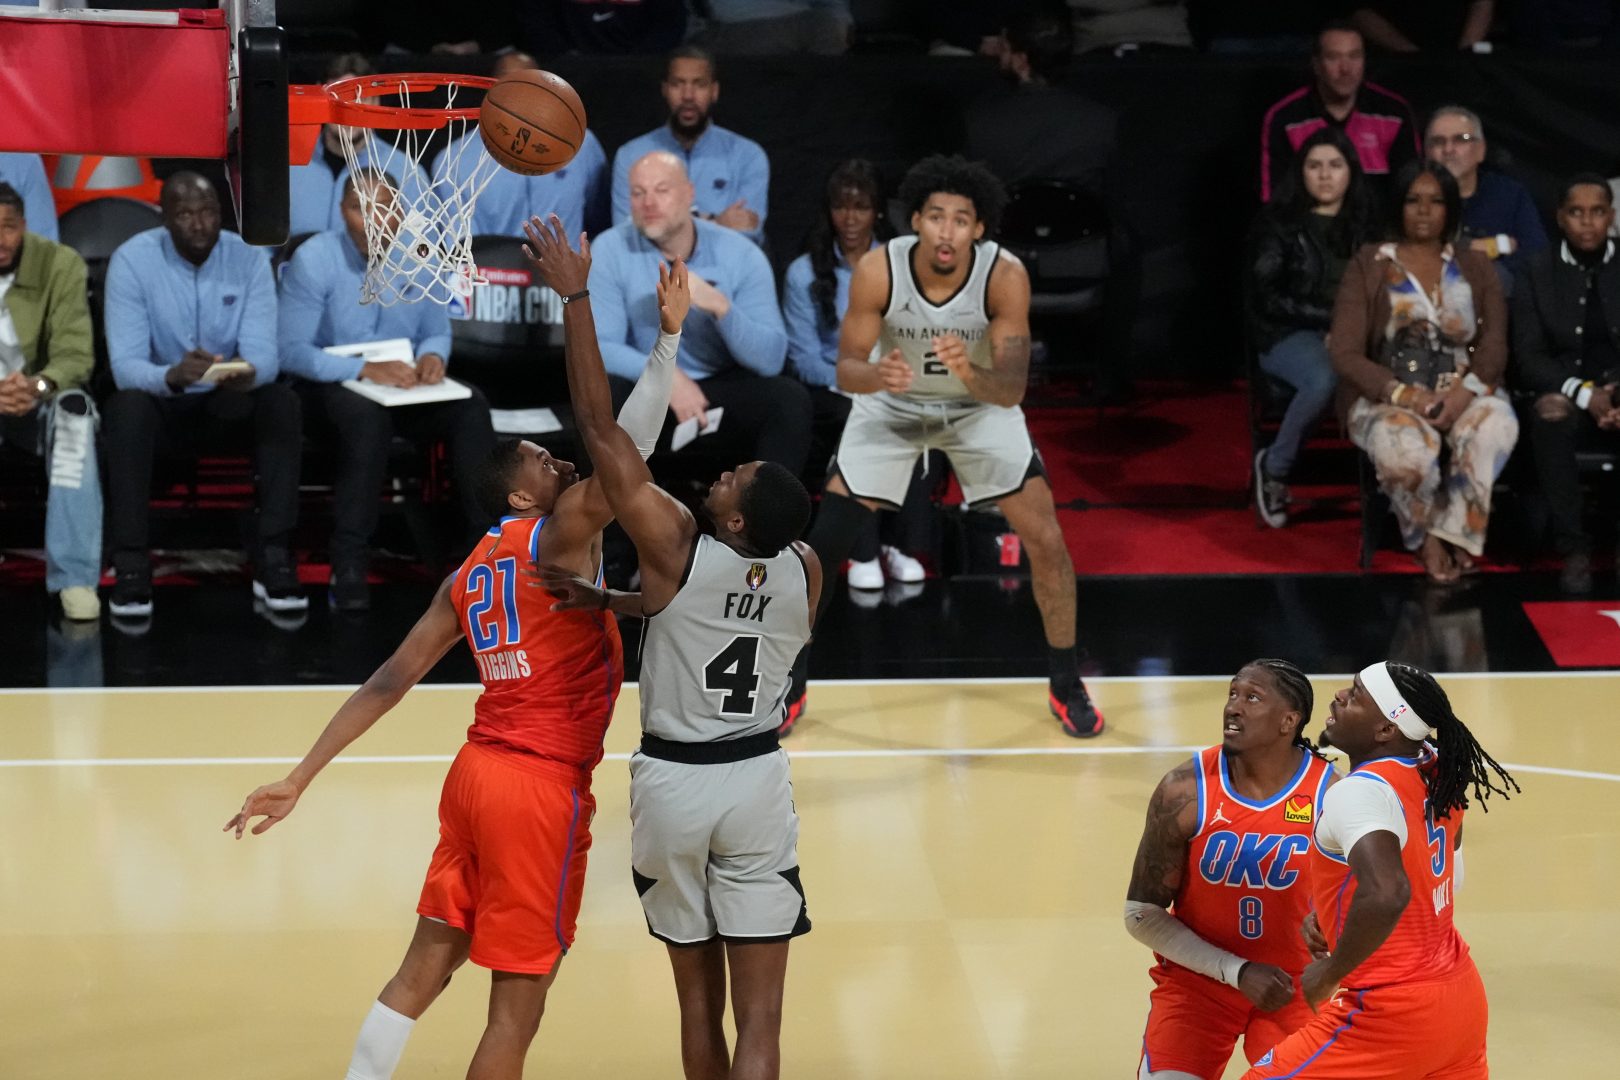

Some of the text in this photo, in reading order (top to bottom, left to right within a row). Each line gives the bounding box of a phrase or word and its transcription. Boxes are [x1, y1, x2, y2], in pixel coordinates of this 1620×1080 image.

[475, 286, 521, 323] NBA
[923, 350, 949, 376] 2
[467, 556, 520, 653] 21
[723, 592, 773, 623] FOX
[702, 633, 764, 718] 4
[1199, 830, 1311, 891] OKC
[1424, 798, 1446, 878] 5
[1238, 895, 1263, 940] 8
